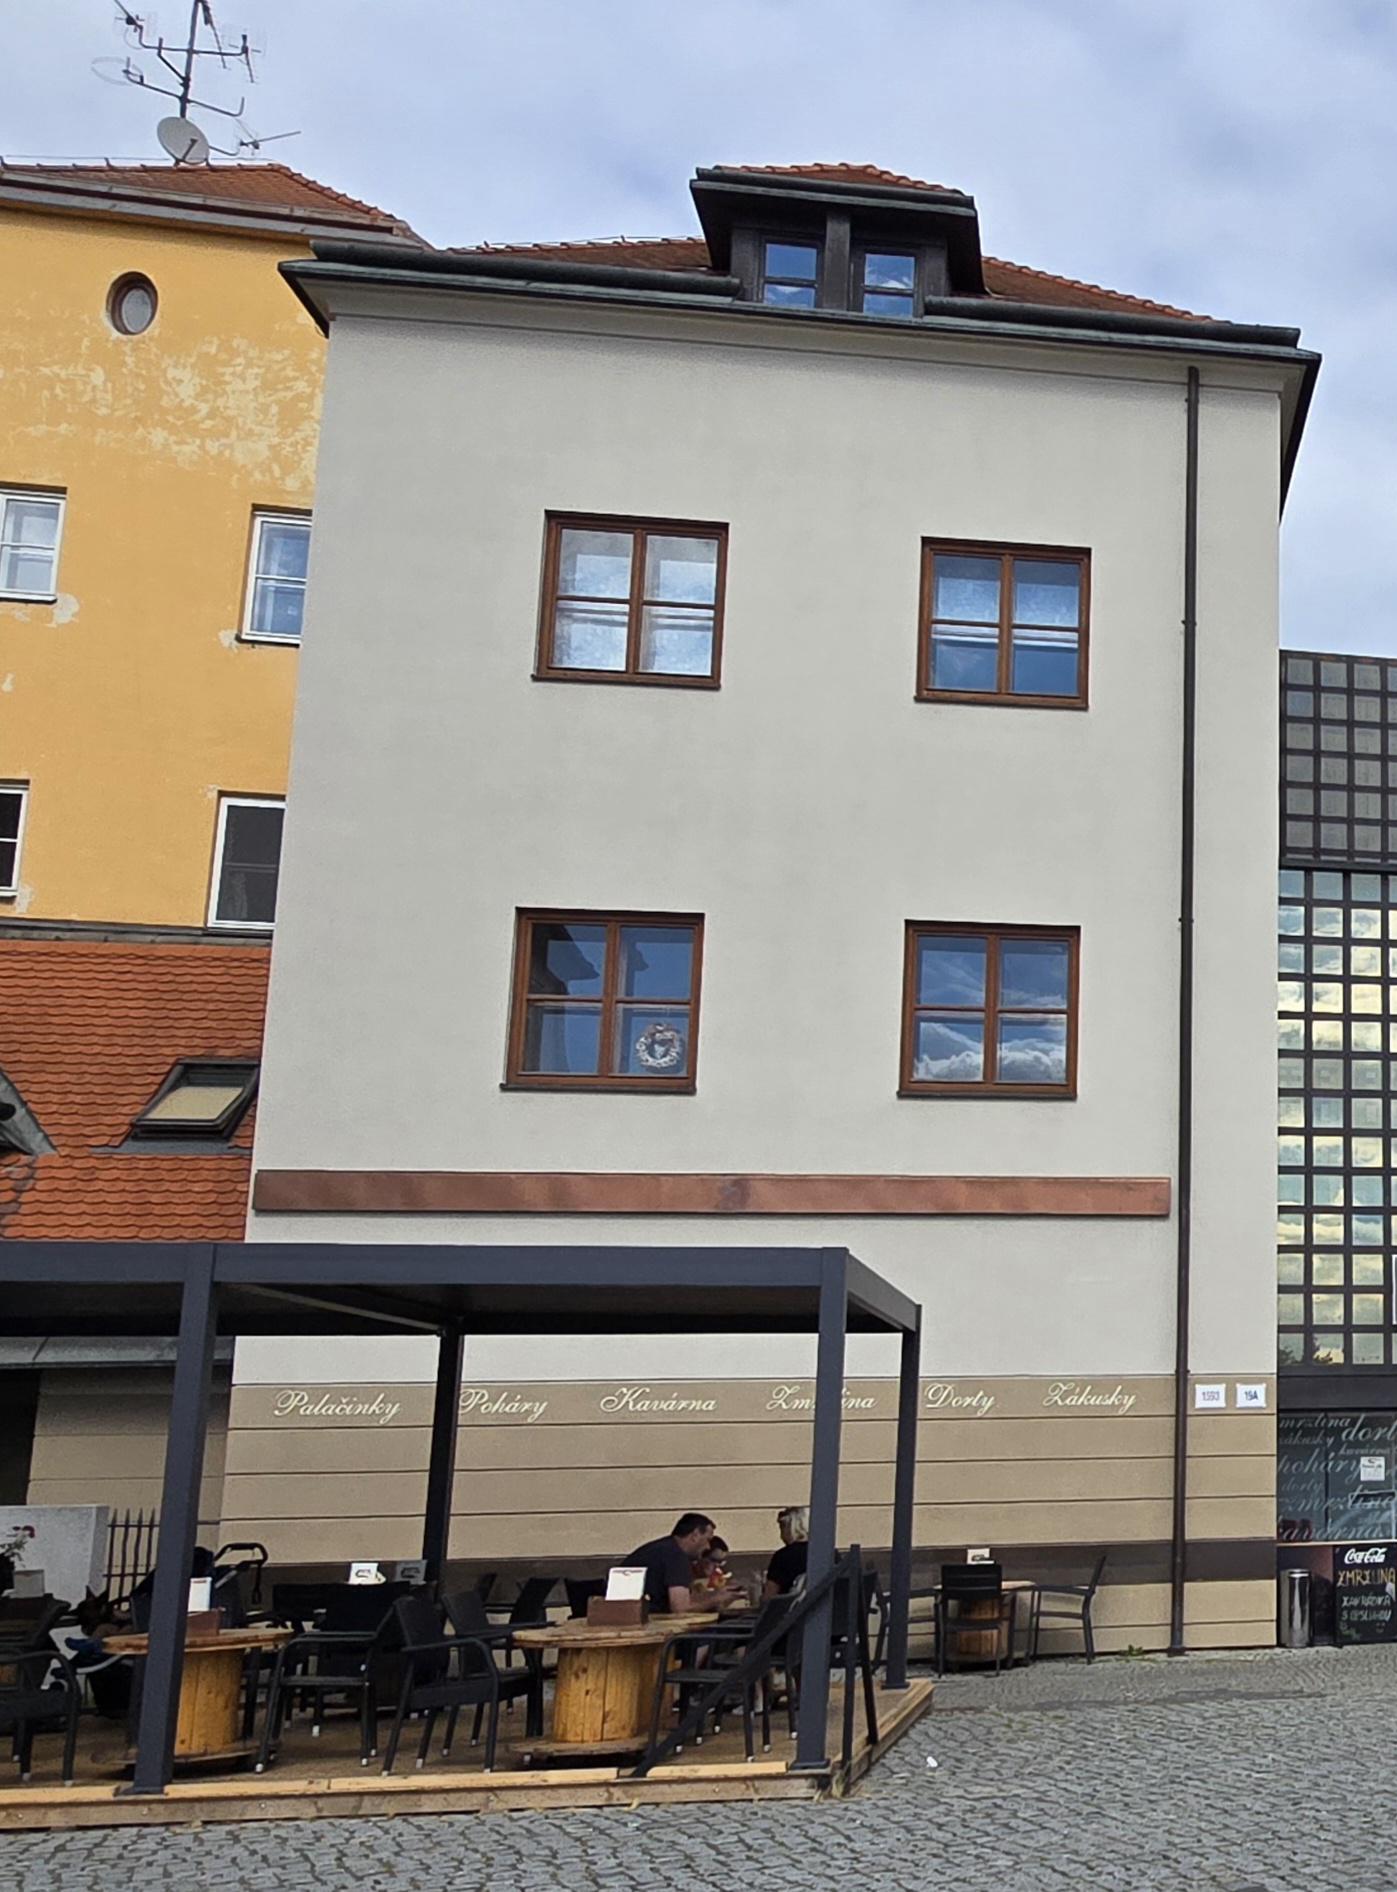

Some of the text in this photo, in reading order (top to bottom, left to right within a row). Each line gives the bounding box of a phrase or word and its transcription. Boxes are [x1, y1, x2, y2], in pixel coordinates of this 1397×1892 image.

[273, 1382, 1136, 1423] Palačinky Poháry Kavárna Zmina Dorty Zákusky
[1344, 1547, 1388, 1565] Coca-Cola
